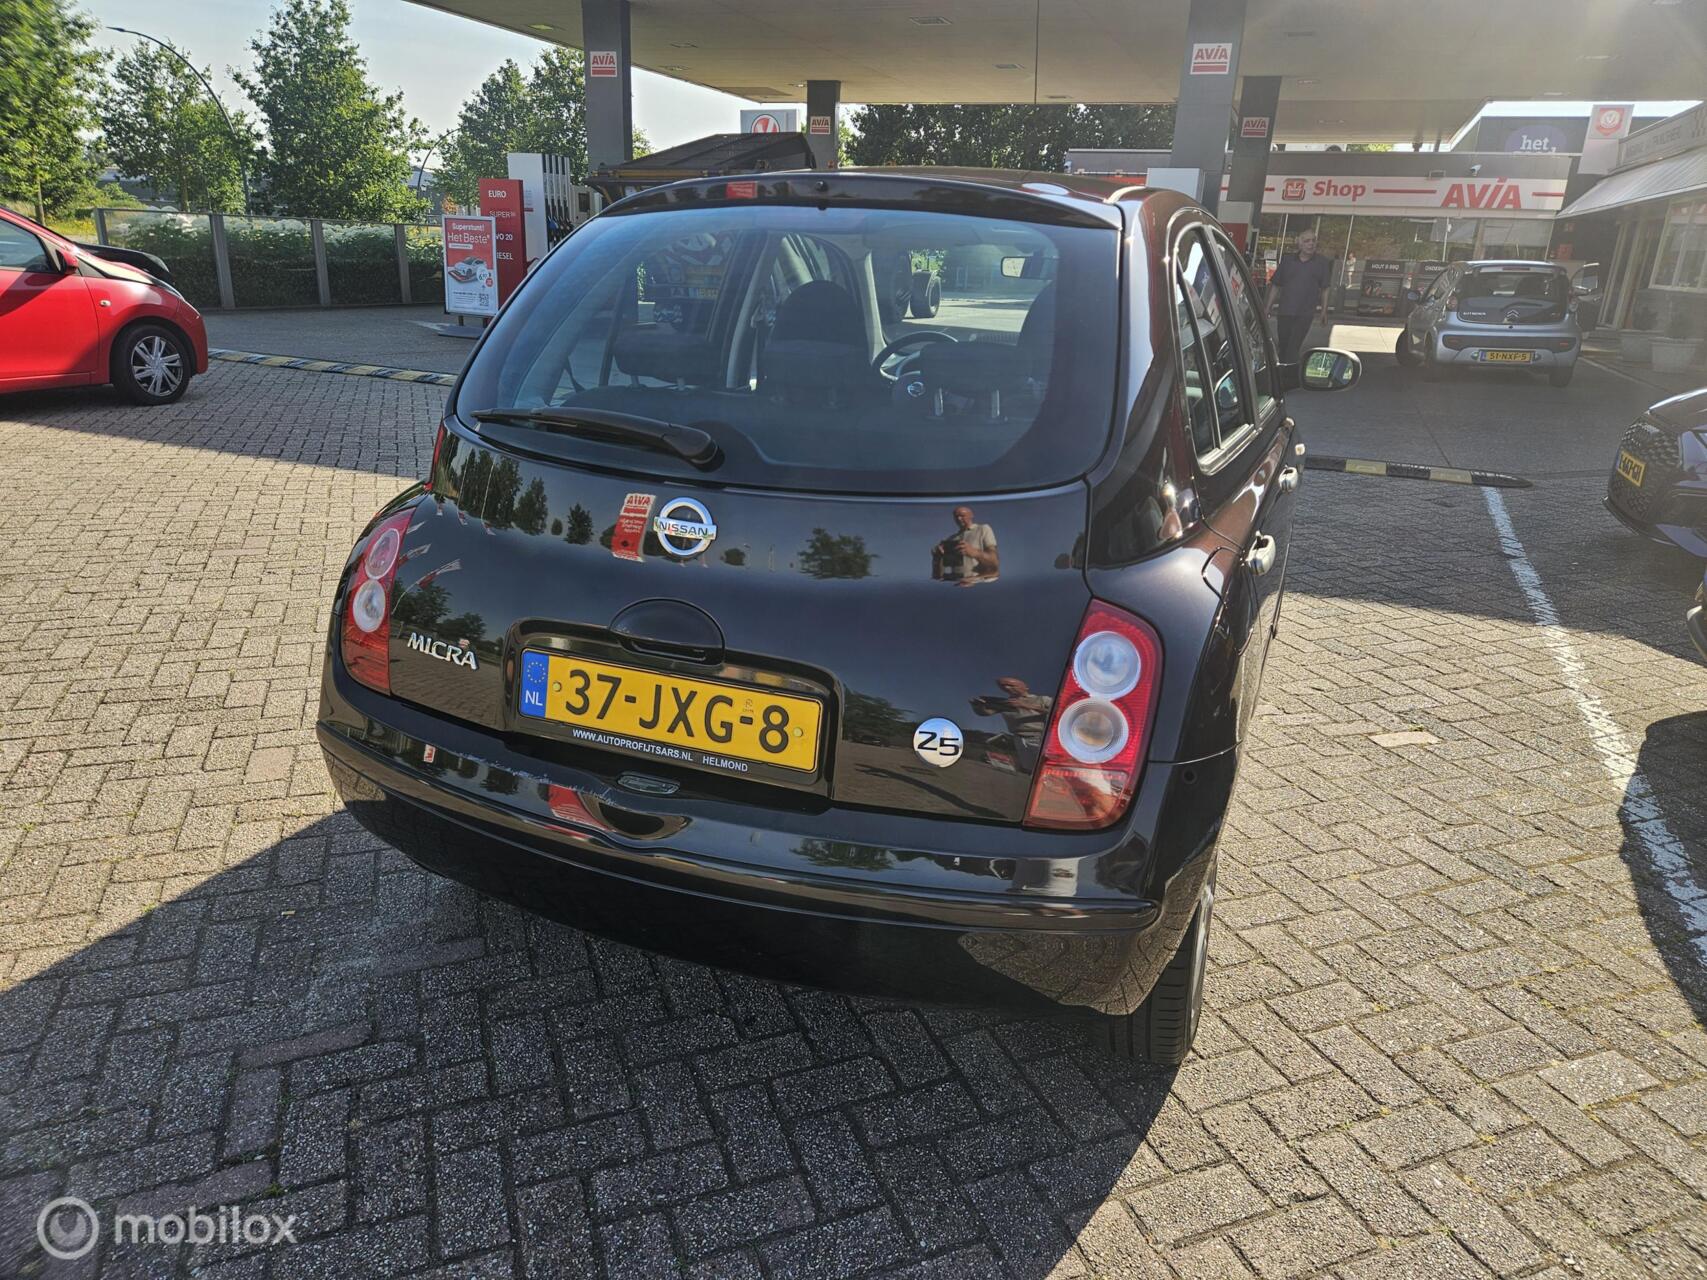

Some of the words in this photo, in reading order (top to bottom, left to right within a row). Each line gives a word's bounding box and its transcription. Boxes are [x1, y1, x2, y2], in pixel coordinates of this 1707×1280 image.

[592, 53, 616, 65] AVIA
[1194, 45, 1228, 60] AVIA
[811, 117, 829, 126] AVIA
[1244, 118, 1267, 129] AVIA
[488, 190, 507, 198] EURO
[1312, 179, 1367, 202] Shop
[1441, 176, 1522, 209] AVIA
[447, 232, 463, 242] Het
[505, 233, 514, 241] 20
[496, 251, 514, 260] IESEL
[658, 521, 709, 536] NISSAN
[407, 632, 478, 671] MICRA
[524, 689, 544, 707] NL
[565, 668, 790, 755] 37-JXG-8
[571, 728, 694, 763] WWW.AUTOPROFIJTSARS.NL
[701, 755, 749, 773] HELMOND
